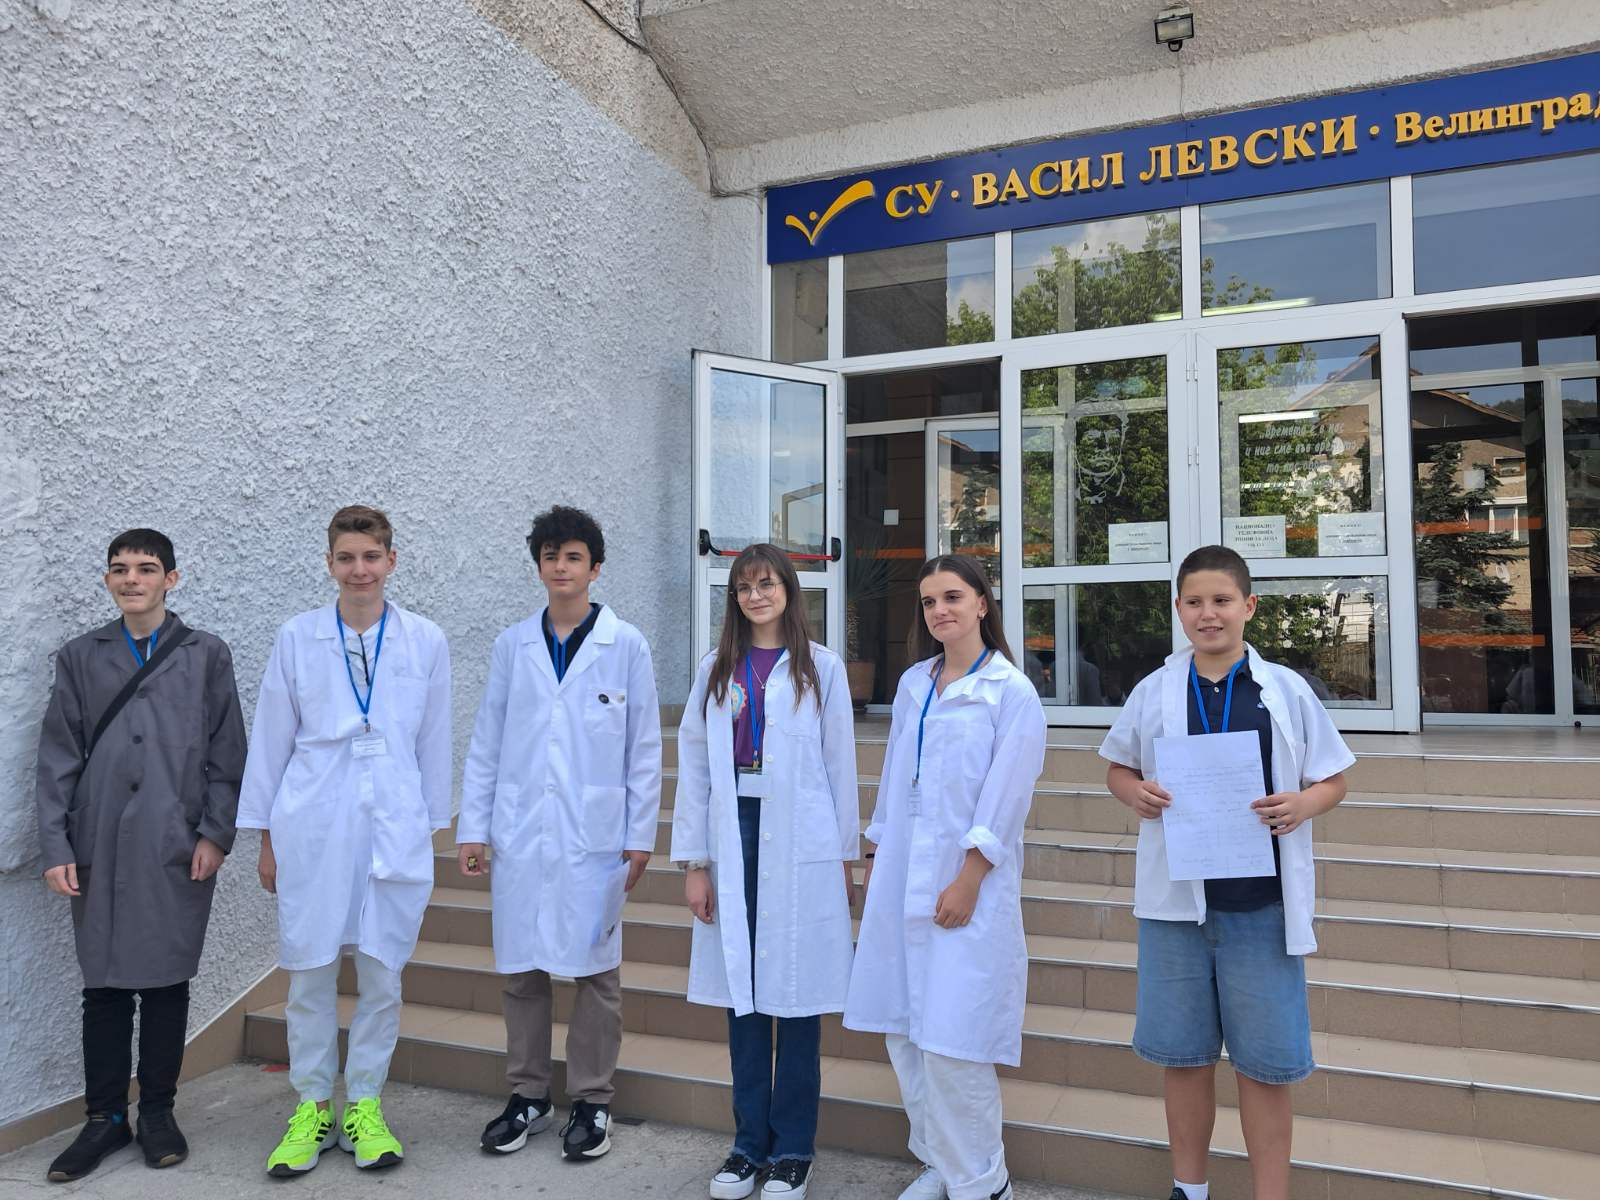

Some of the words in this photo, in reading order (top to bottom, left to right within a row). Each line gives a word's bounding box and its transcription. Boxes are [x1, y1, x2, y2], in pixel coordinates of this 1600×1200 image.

[885, 180, 944, 219] СУ
[972, 152, 1124, 207] ВАСИЛ
[1139, 115, 1358, 182] ЛЕВСКИ
[1394, 91, 1600, 143] Велингра
